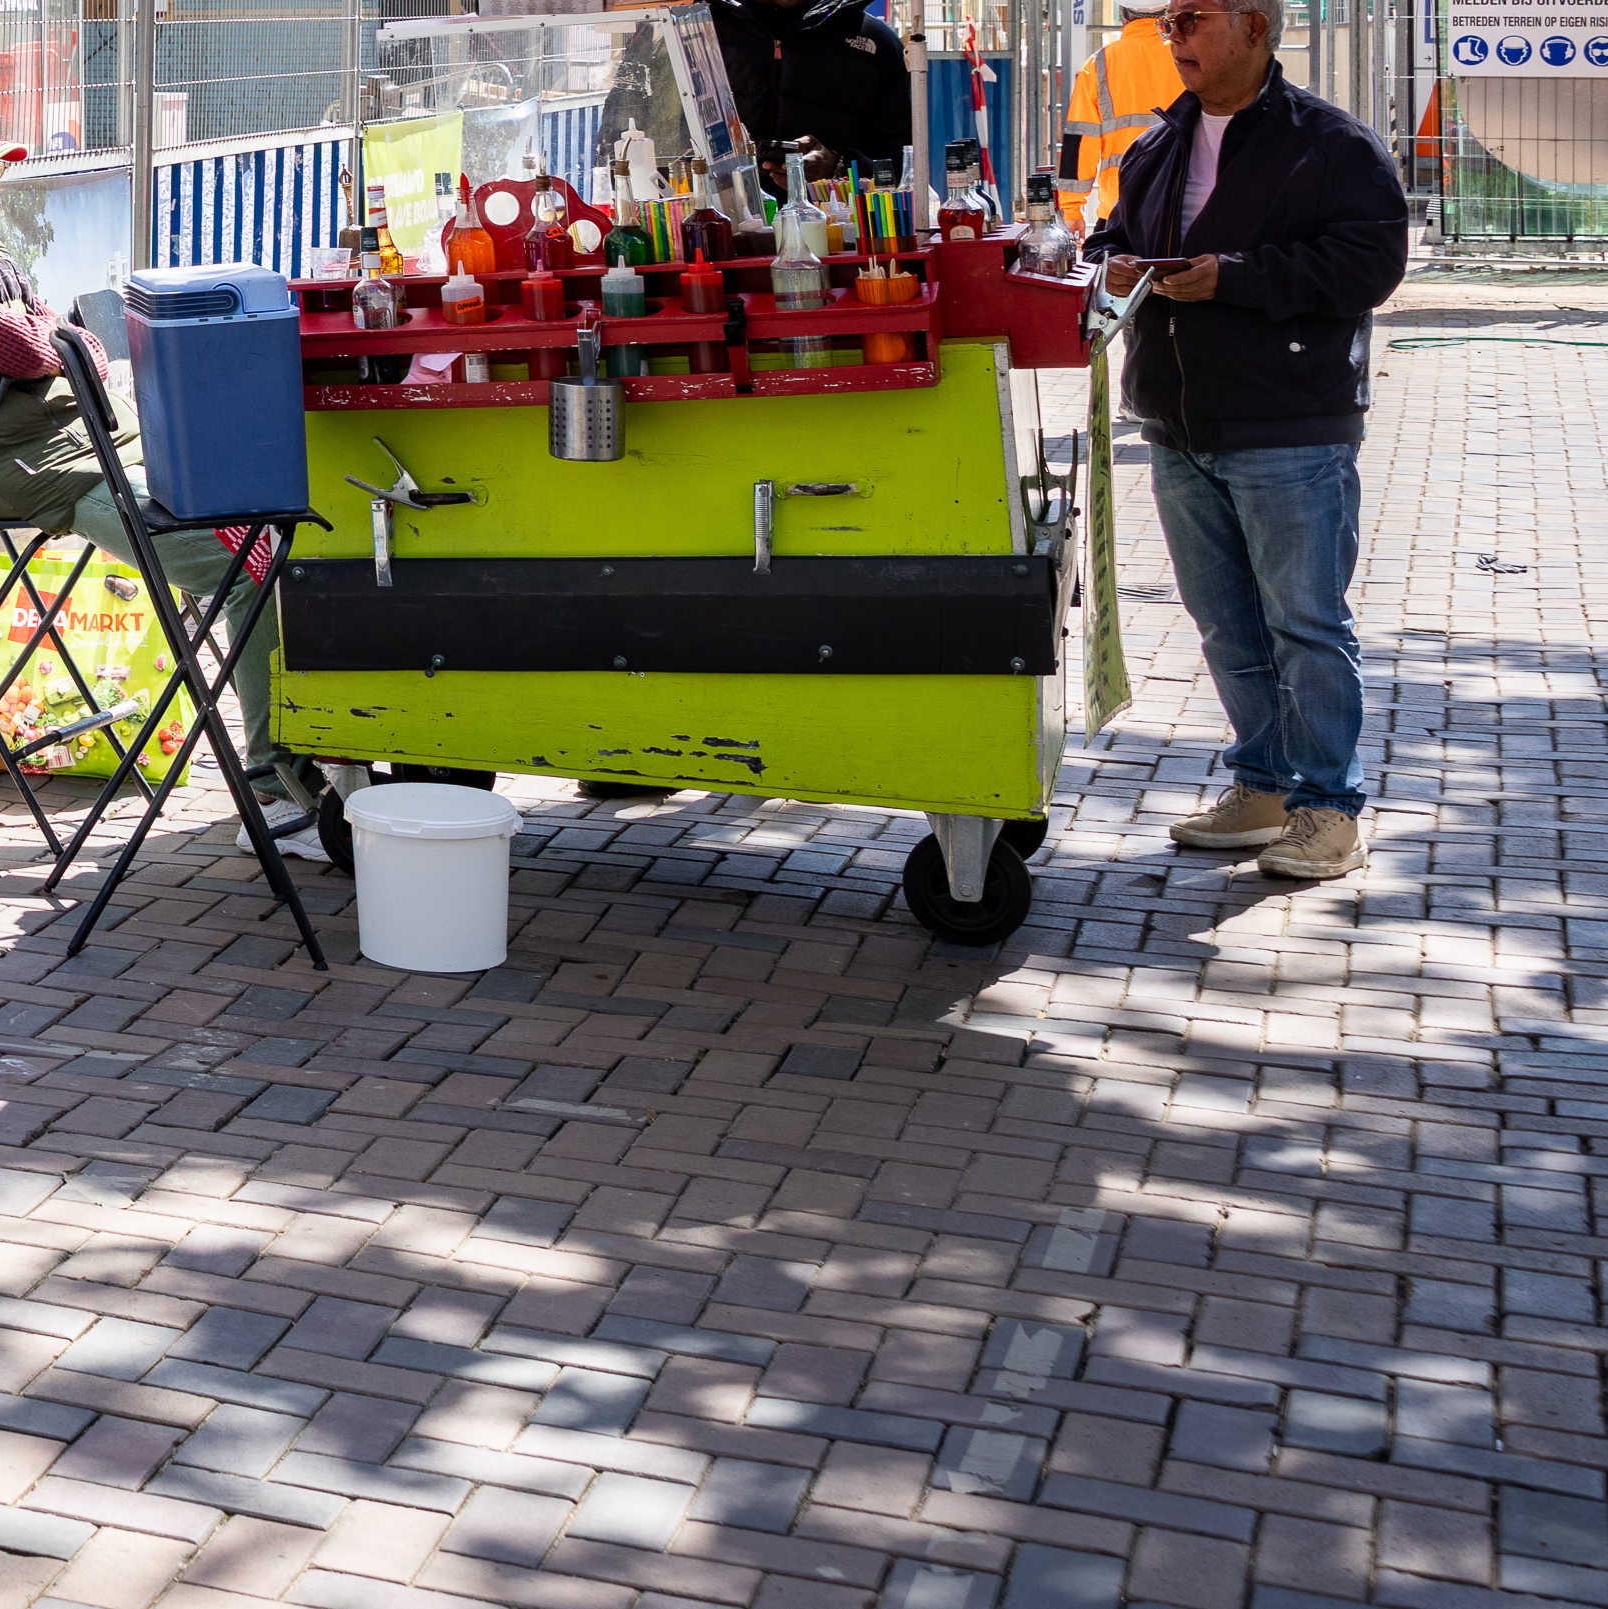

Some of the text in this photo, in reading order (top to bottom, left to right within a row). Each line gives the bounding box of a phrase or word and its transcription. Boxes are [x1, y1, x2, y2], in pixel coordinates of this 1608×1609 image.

[1453, 16, 1500, 27] BETREDEN
[1503, 16, 1541, 27] TERREIN
[1545, 16, 1557, 27] OP
[1560, 16, 1586, 27] EIGEN
